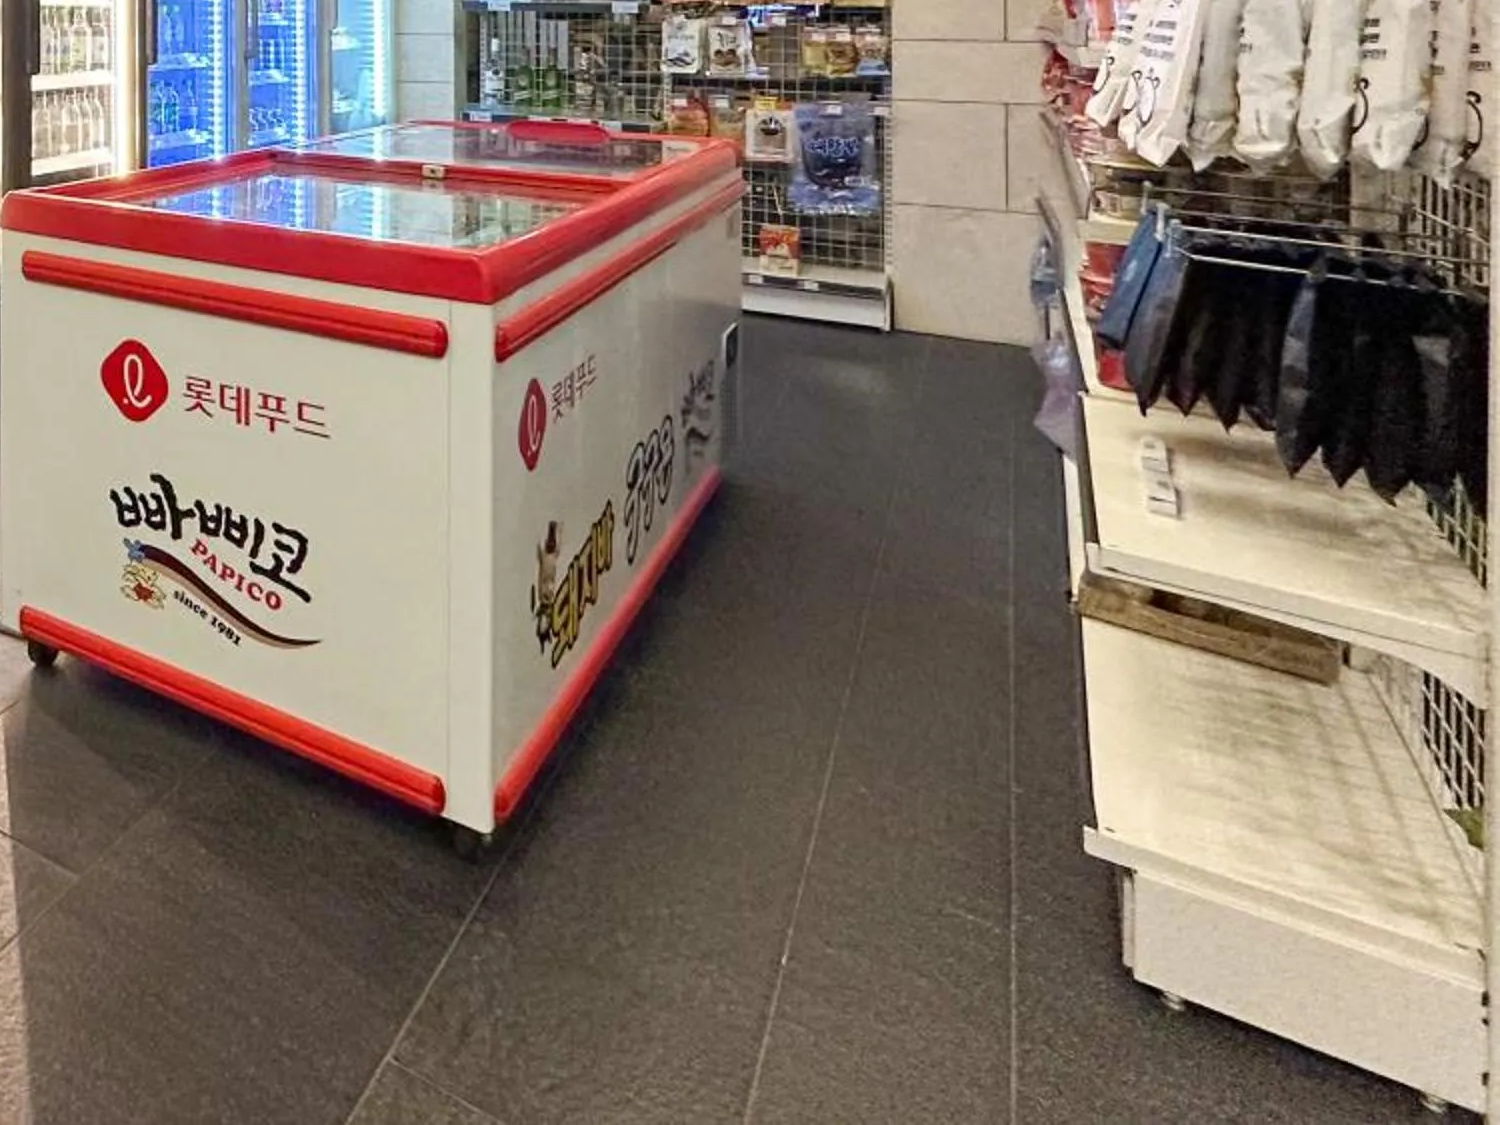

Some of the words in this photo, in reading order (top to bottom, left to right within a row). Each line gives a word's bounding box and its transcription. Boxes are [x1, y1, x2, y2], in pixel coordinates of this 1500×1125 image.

[182, 375, 331, 439] 롯데푸드
[109, 473, 312, 604] 빠삐코
[190, 538, 283, 612] PAPICO
[173, 589, 209, 620] since
[211, 617, 243, 647] 1981
